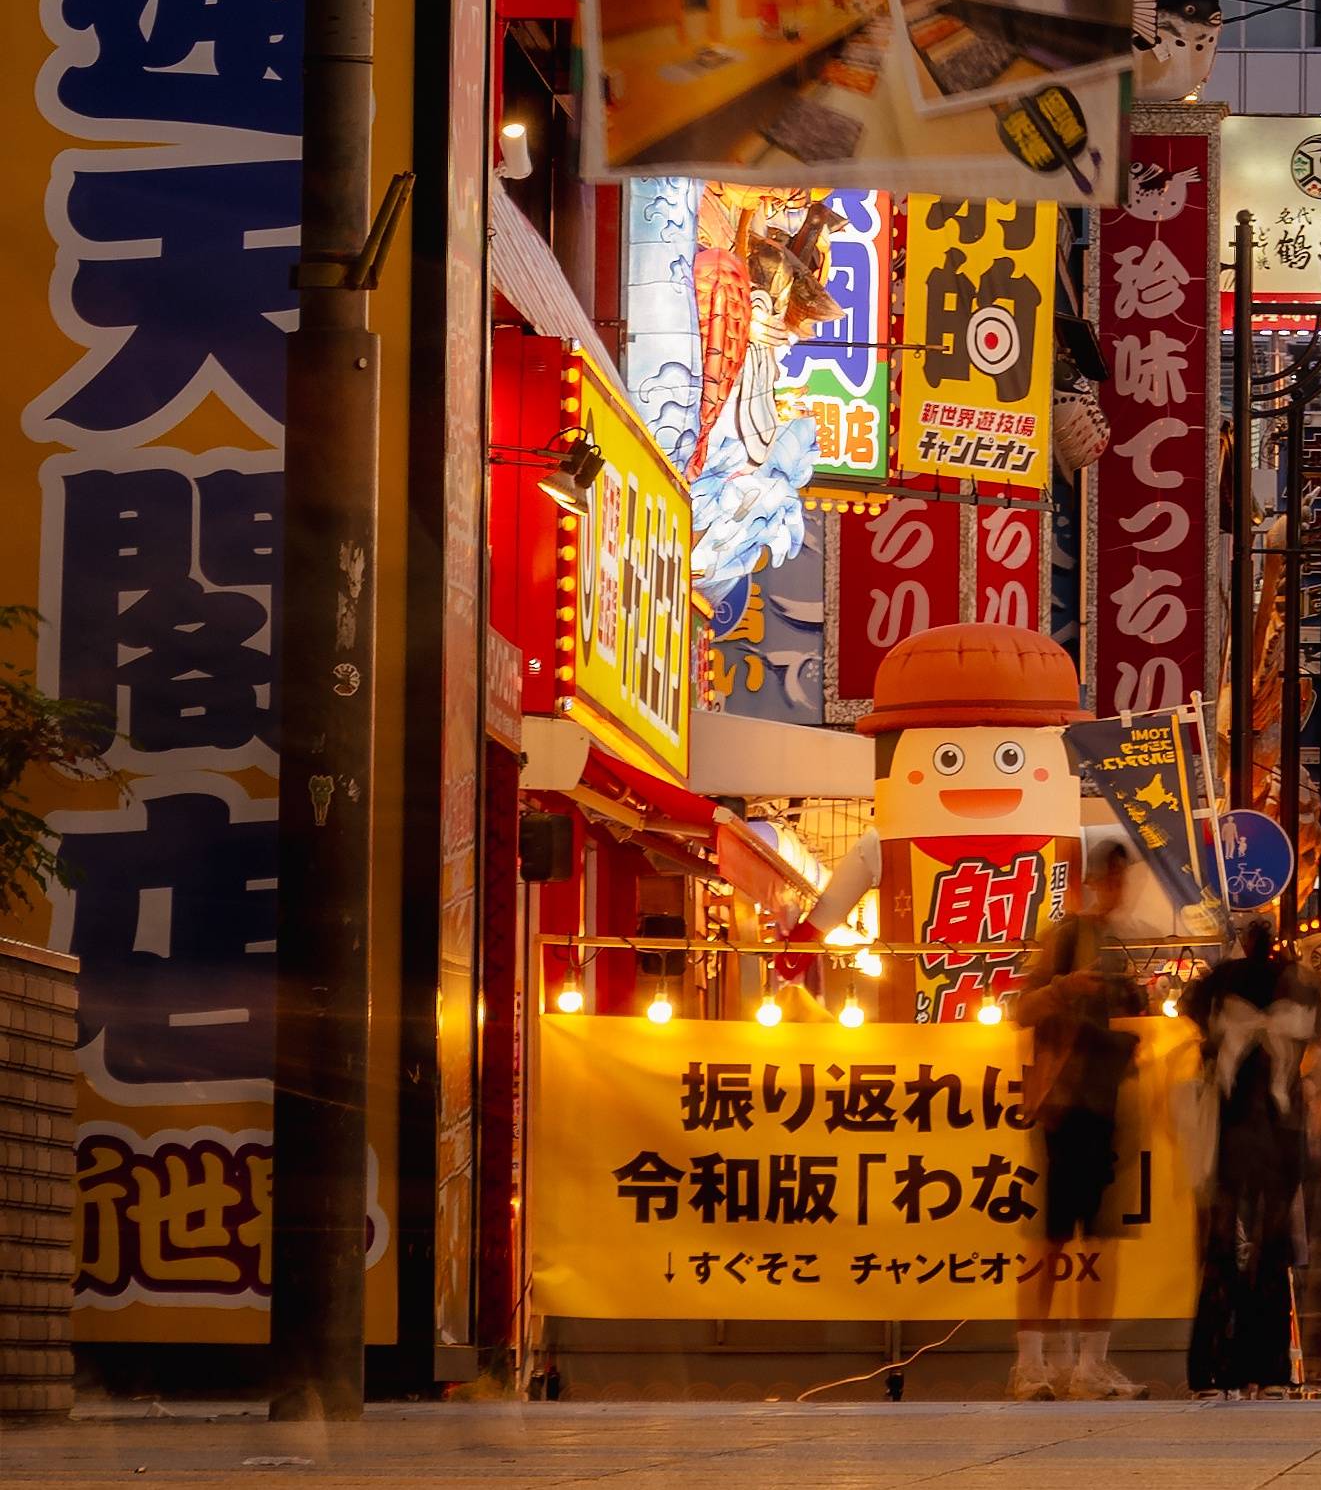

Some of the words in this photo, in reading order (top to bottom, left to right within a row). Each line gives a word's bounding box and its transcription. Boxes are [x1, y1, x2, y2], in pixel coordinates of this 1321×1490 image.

[921, 403, 1036, 437] 新世界遊技場
[919, 431, 1035, 473] チャンピオン
[611, 1150, 1152, 1226] 令和版「わな」
[688, 1251, 821, 1284] すぐそこ
